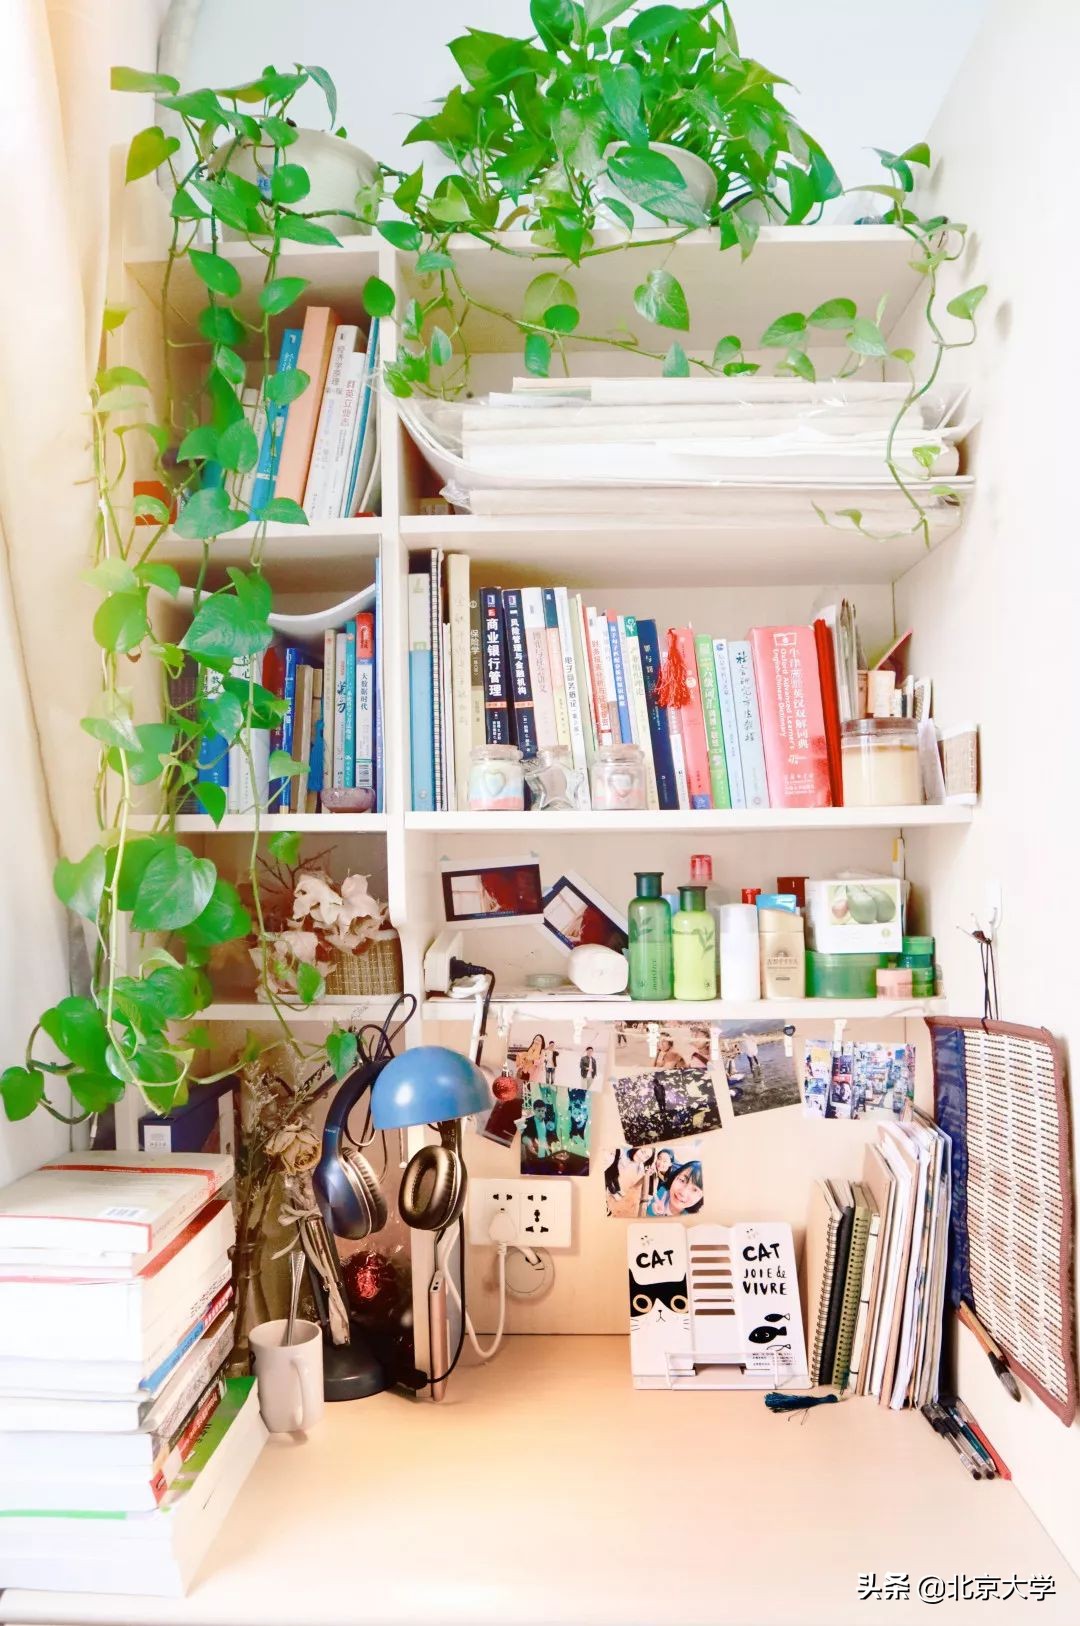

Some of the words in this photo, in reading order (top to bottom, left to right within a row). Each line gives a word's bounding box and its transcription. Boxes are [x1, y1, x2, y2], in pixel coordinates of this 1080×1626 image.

[486, 618, 503, 697] 商业银行管理
[510, 618, 527, 696] 风险管理与金融机构
[360, 672, 368, 711] 大数据时代
[636, 1249, 674, 1269] CAT
[743, 1243, 780, 1262] CAT
[743, 1268, 772, 1279] JOIE
[776, 1265, 787, 1279] de
[743, 1281, 788, 1296] VIVRE
